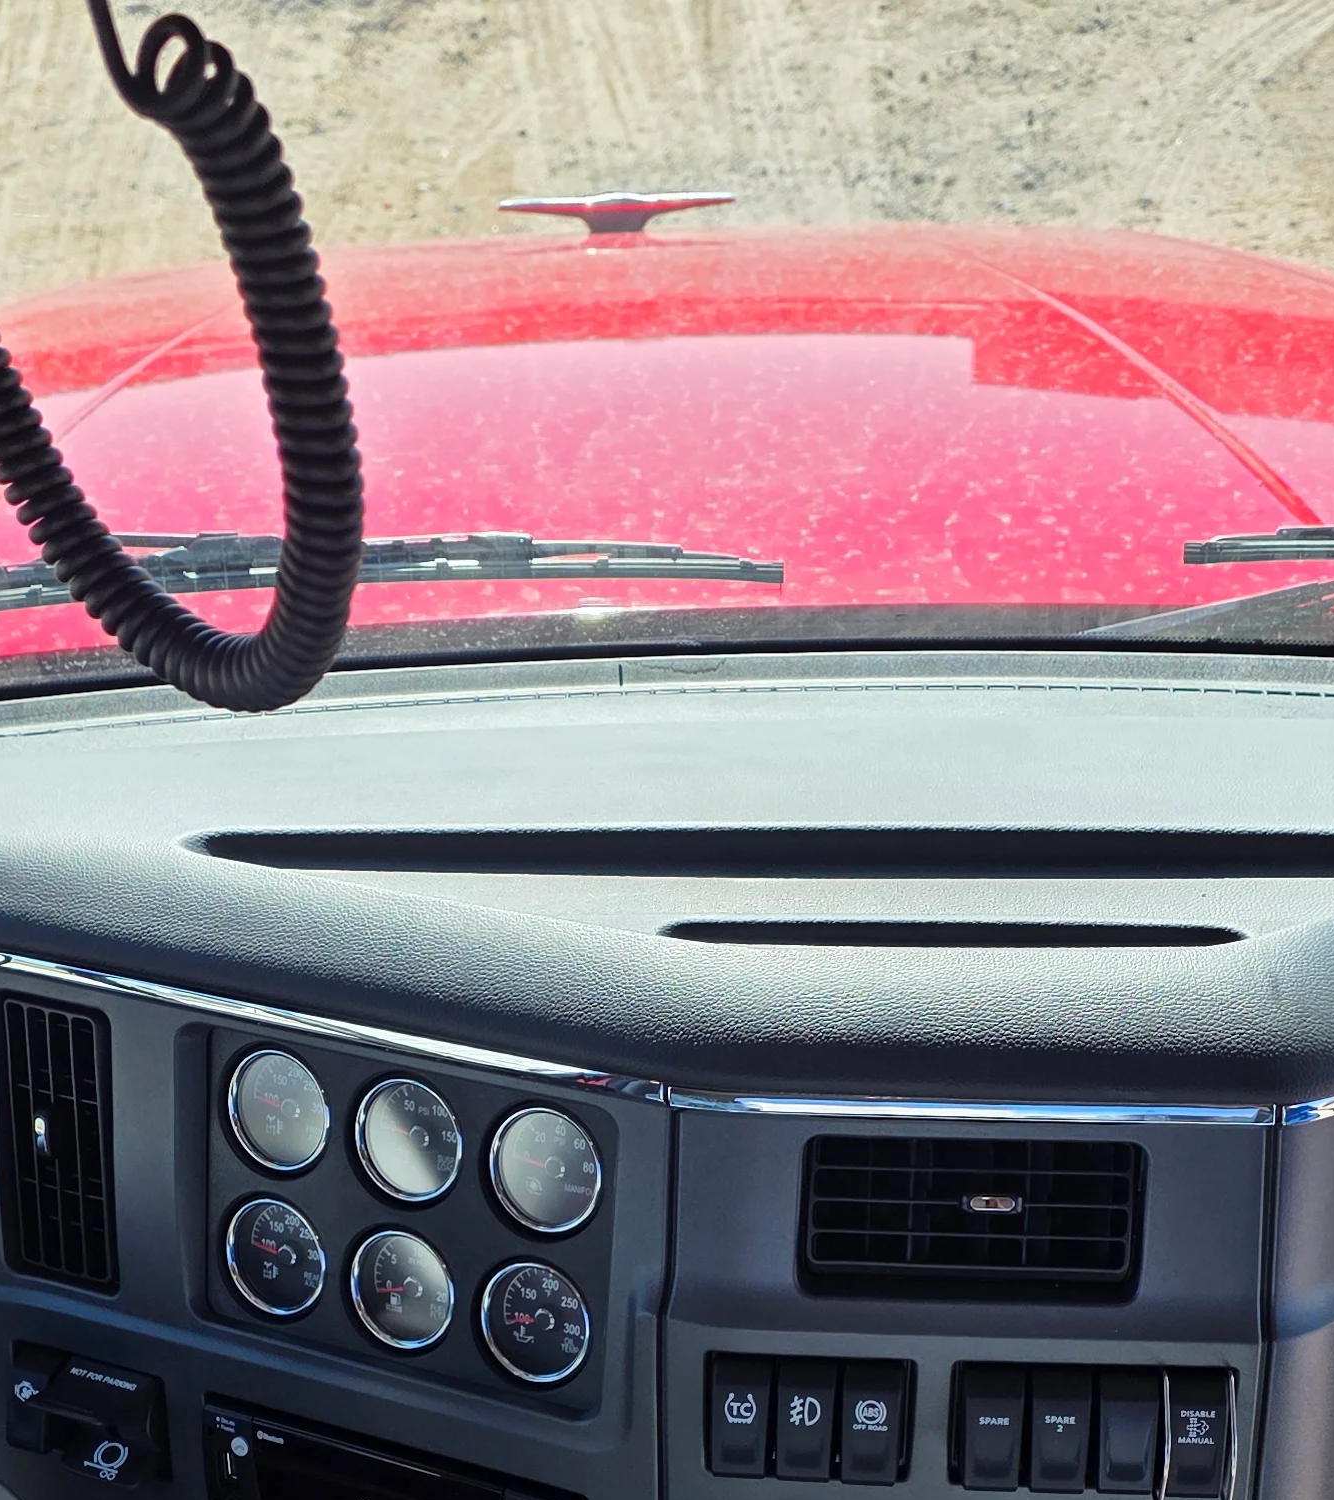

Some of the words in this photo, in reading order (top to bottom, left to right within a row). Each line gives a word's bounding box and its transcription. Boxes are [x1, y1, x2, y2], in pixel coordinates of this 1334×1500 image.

[273, 1074, 287, 1086] 150
[288, 1067, 304, 1080] 200
[403, 1100, 415, 1112] 50
[418, 1106, 430, 1116] PSI
[432, 1104, 448, 1118] 100
[441, 1130, 457, 1144] 150
[534, 1131, 547, 1143] 20
[555, 1124, 567, 1138] 40
[573, 1138, 586, 1150] 60
[583, 1162, 595, 1174] 80
[269, 1220, 284, 1234] 150
[285, 1214, 300, 1228] 200
[542, 1277, 559, 1291] 200
[520, 1288, 537, 1301] 150
[561, 1296, 579, 1310] 250
[563, 1322, 581, 1337] 300
[70, 1367, 87, 1377] NOT
[86, 1372, 104, 1382] FOR
[102, 1376, 137, 1392] PARKING
[729, 1402, 753, 1418] TC
[861, 1406, 880, 1419] ABS
[1180, 1410, 1216, 1419] DISABLE
[978, 1416, 1010, 1426] SPARE
[1044, 1415, 1076, 1425] SPARE
[852, 1423, 867, 1432] OFF
[868, 1424, 888, 1433] ROAD
[1057, 1424, 1064, 1433] 2
[1177, 1436, 1215, 1446] MANUAL
